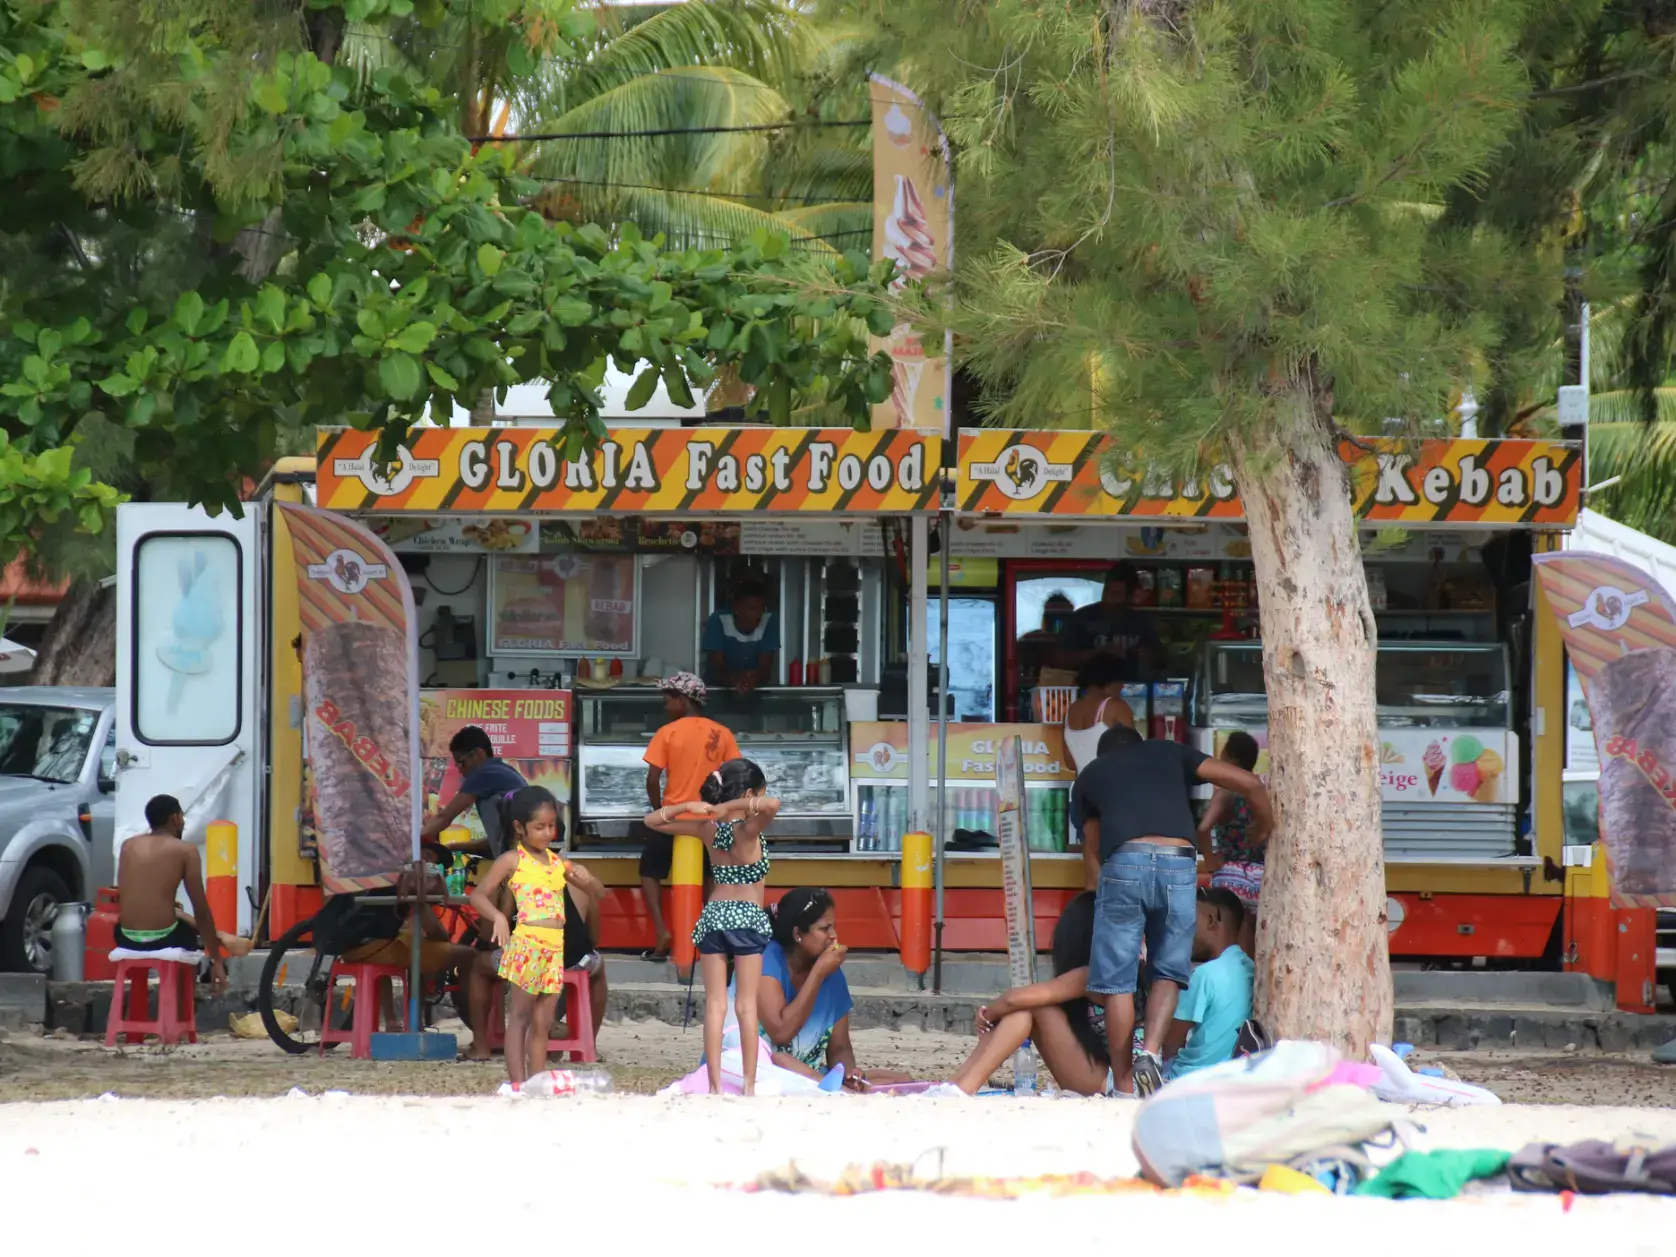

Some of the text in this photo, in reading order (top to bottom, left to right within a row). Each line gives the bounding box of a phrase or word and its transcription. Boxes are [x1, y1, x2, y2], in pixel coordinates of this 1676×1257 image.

[348, 462, 365, 471] Halal
[458, 440, 925, 494] GLORIA Fast Food
[1375, 453, 1568, 508] Kebab
[446, 699, 564, 720] CHINESE FOODS
[485, 723, 508, 733] FRITE
[485, 734, 517, 744] OUILLE
[972, 740, 1050, 755] GLIA
[962, 759, 1060, 774] Fas ood
[1379, 770, 1418, 791] eige
